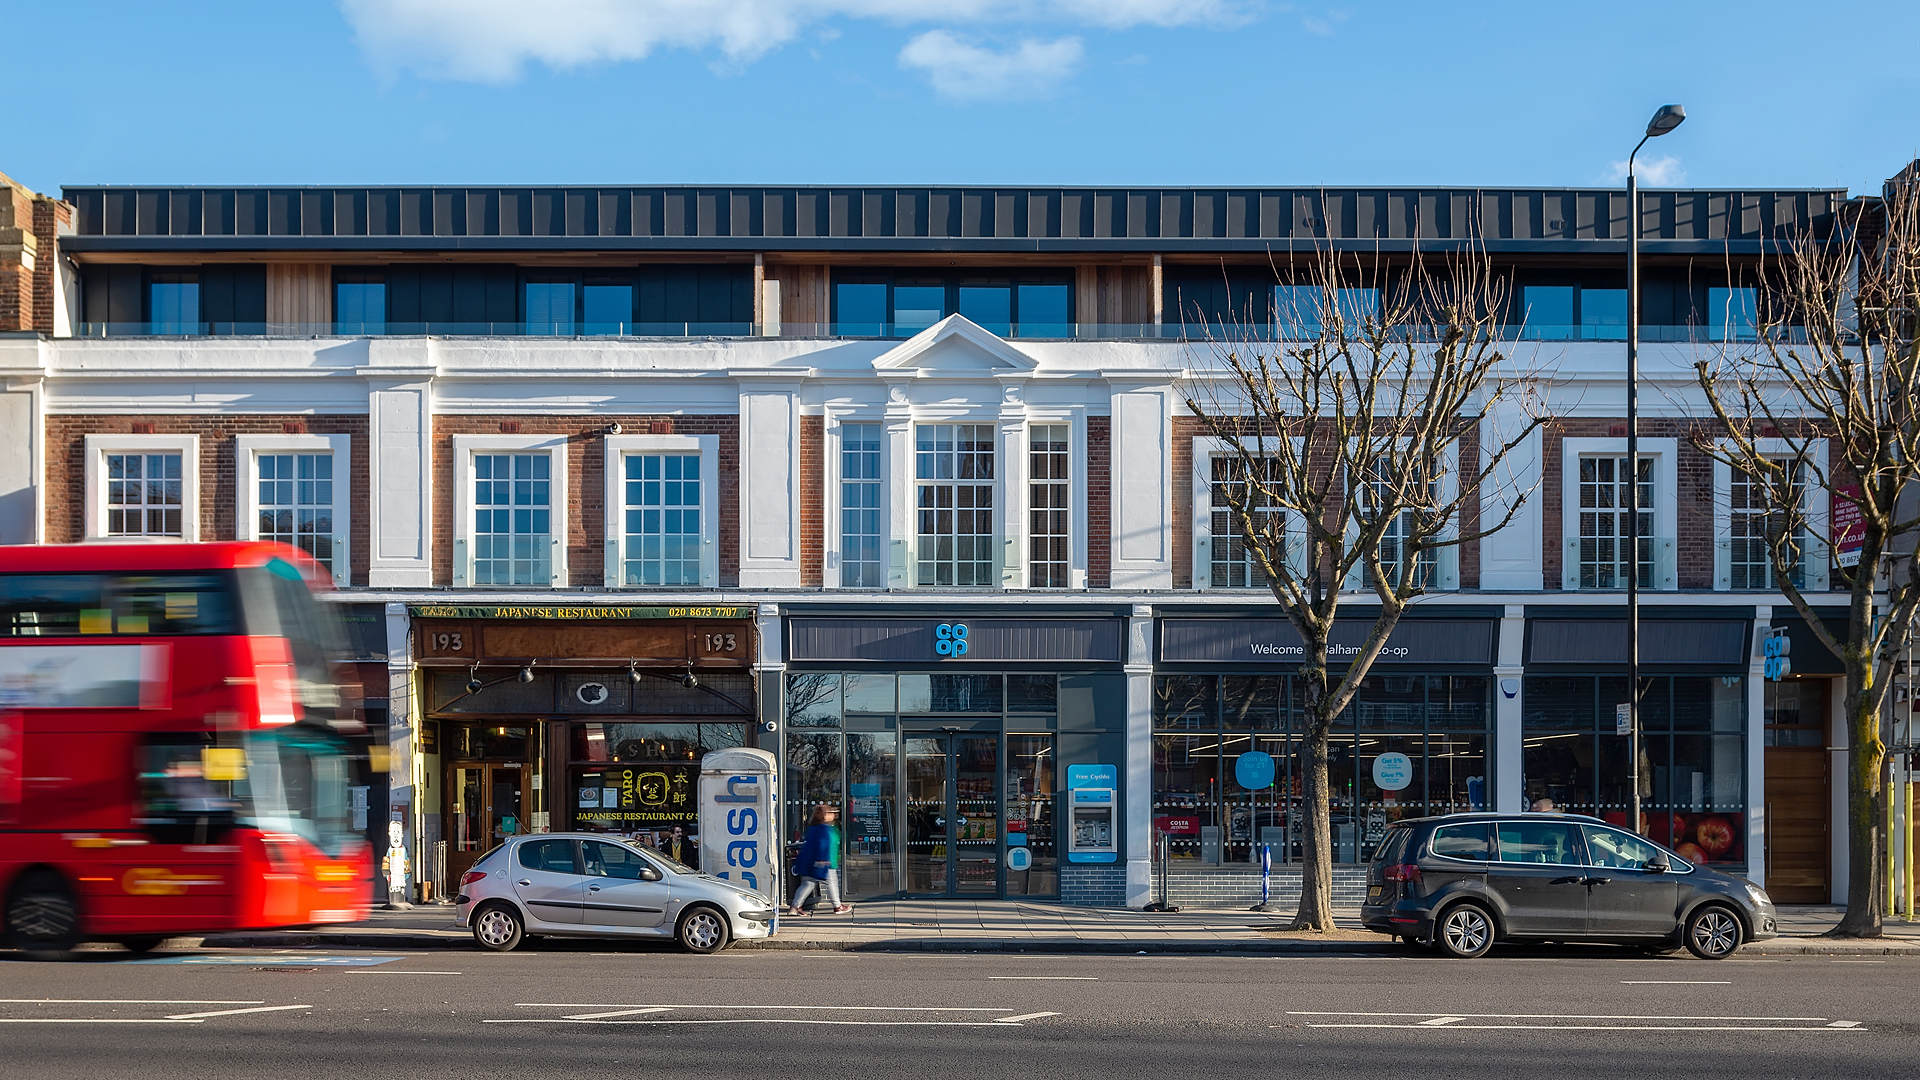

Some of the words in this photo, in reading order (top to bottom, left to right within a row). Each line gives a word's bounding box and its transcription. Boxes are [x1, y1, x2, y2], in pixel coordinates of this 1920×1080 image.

[1834, 531, 1866, 545] kn.co.uk
[420, 606, 457, 616] TARO
[495, 608, 553, 618] JAPANESE
[557, 608, 633, 618] RESTAURANT
[668, 608, 686, 617] 020
[690, 607, 712, 617] 8673
[716, 607, 738, 616] 7707
[432, 633, 463, 651] 193
[705, 634, 737, 652] 193
[1250, 643, 1304, 654] Welcome
[622, 769, 633, 806] TARO
